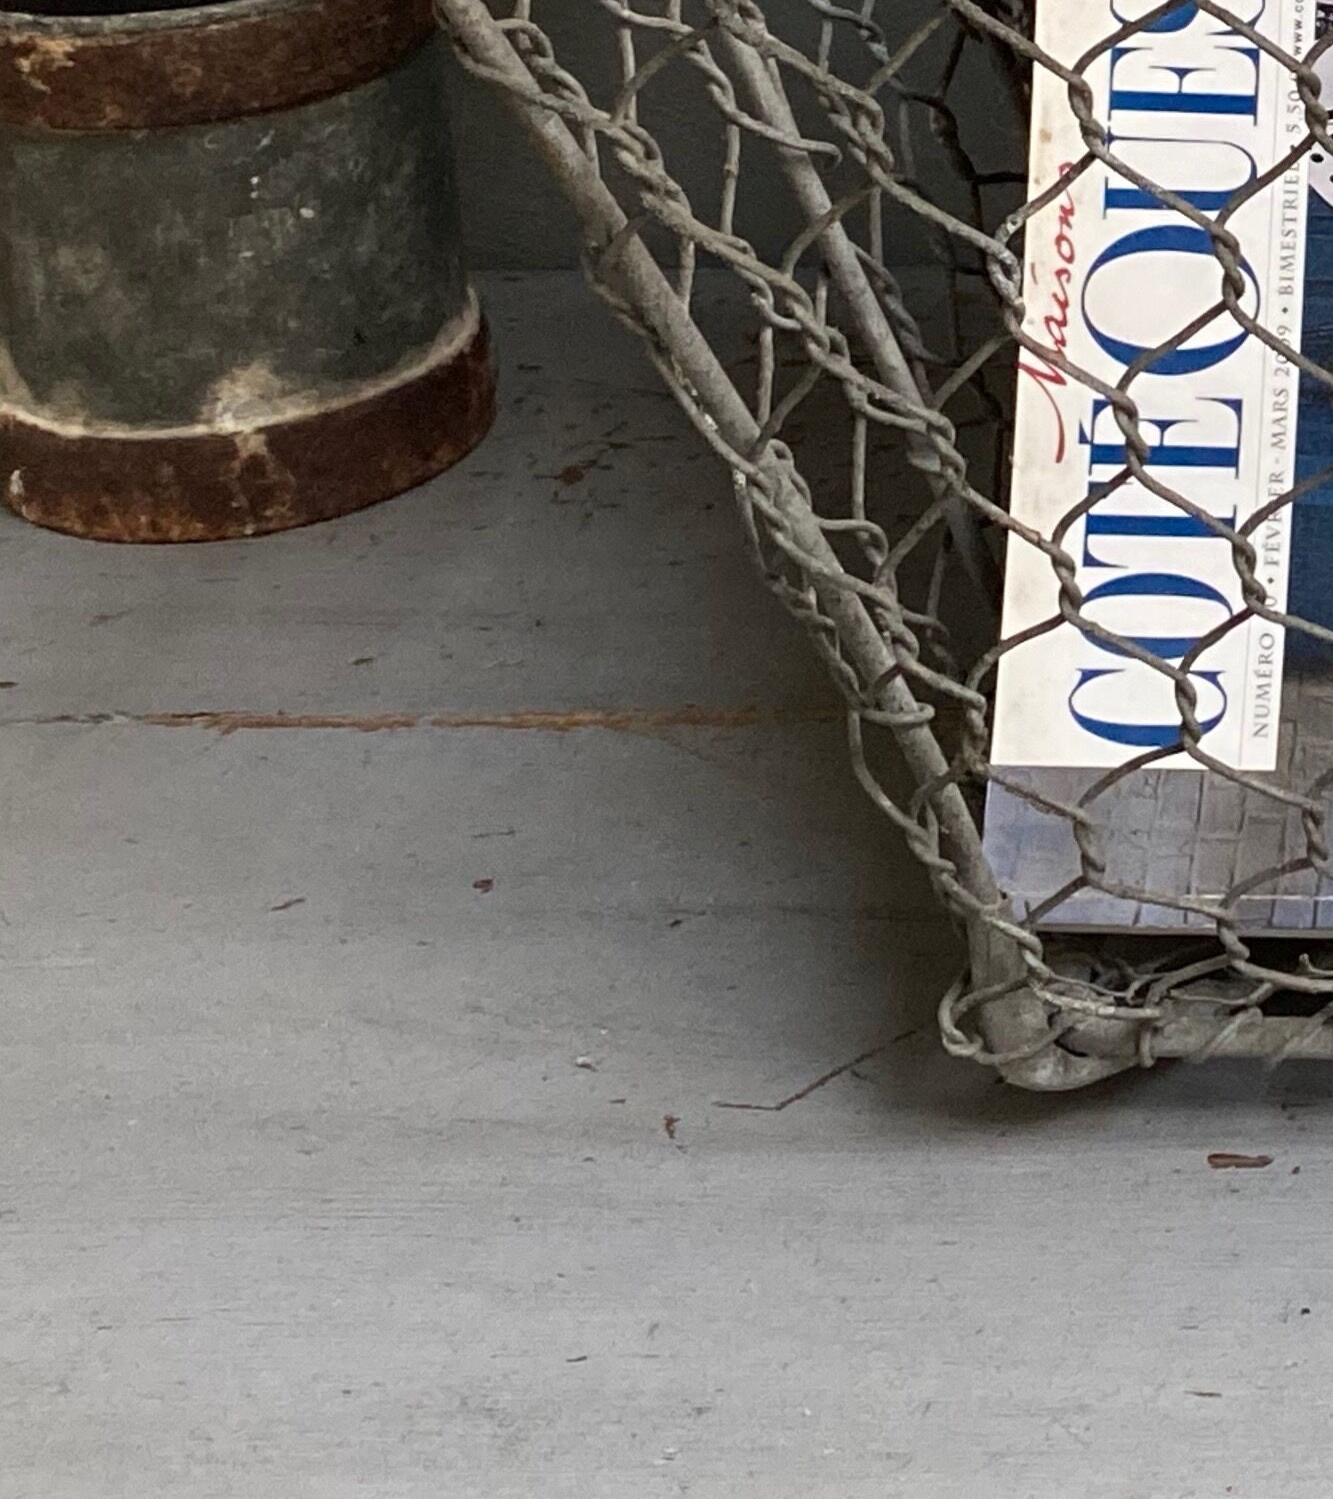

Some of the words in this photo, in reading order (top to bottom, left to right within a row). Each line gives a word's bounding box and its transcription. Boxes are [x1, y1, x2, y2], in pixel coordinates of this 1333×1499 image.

[1273, 323, 1295, 378] 209
[1269, 387, 1291, 451] MARS
[1258, 470, 1286, 567] FÉVRER
[1251, 631, 1276, 740] NUMÉRO
